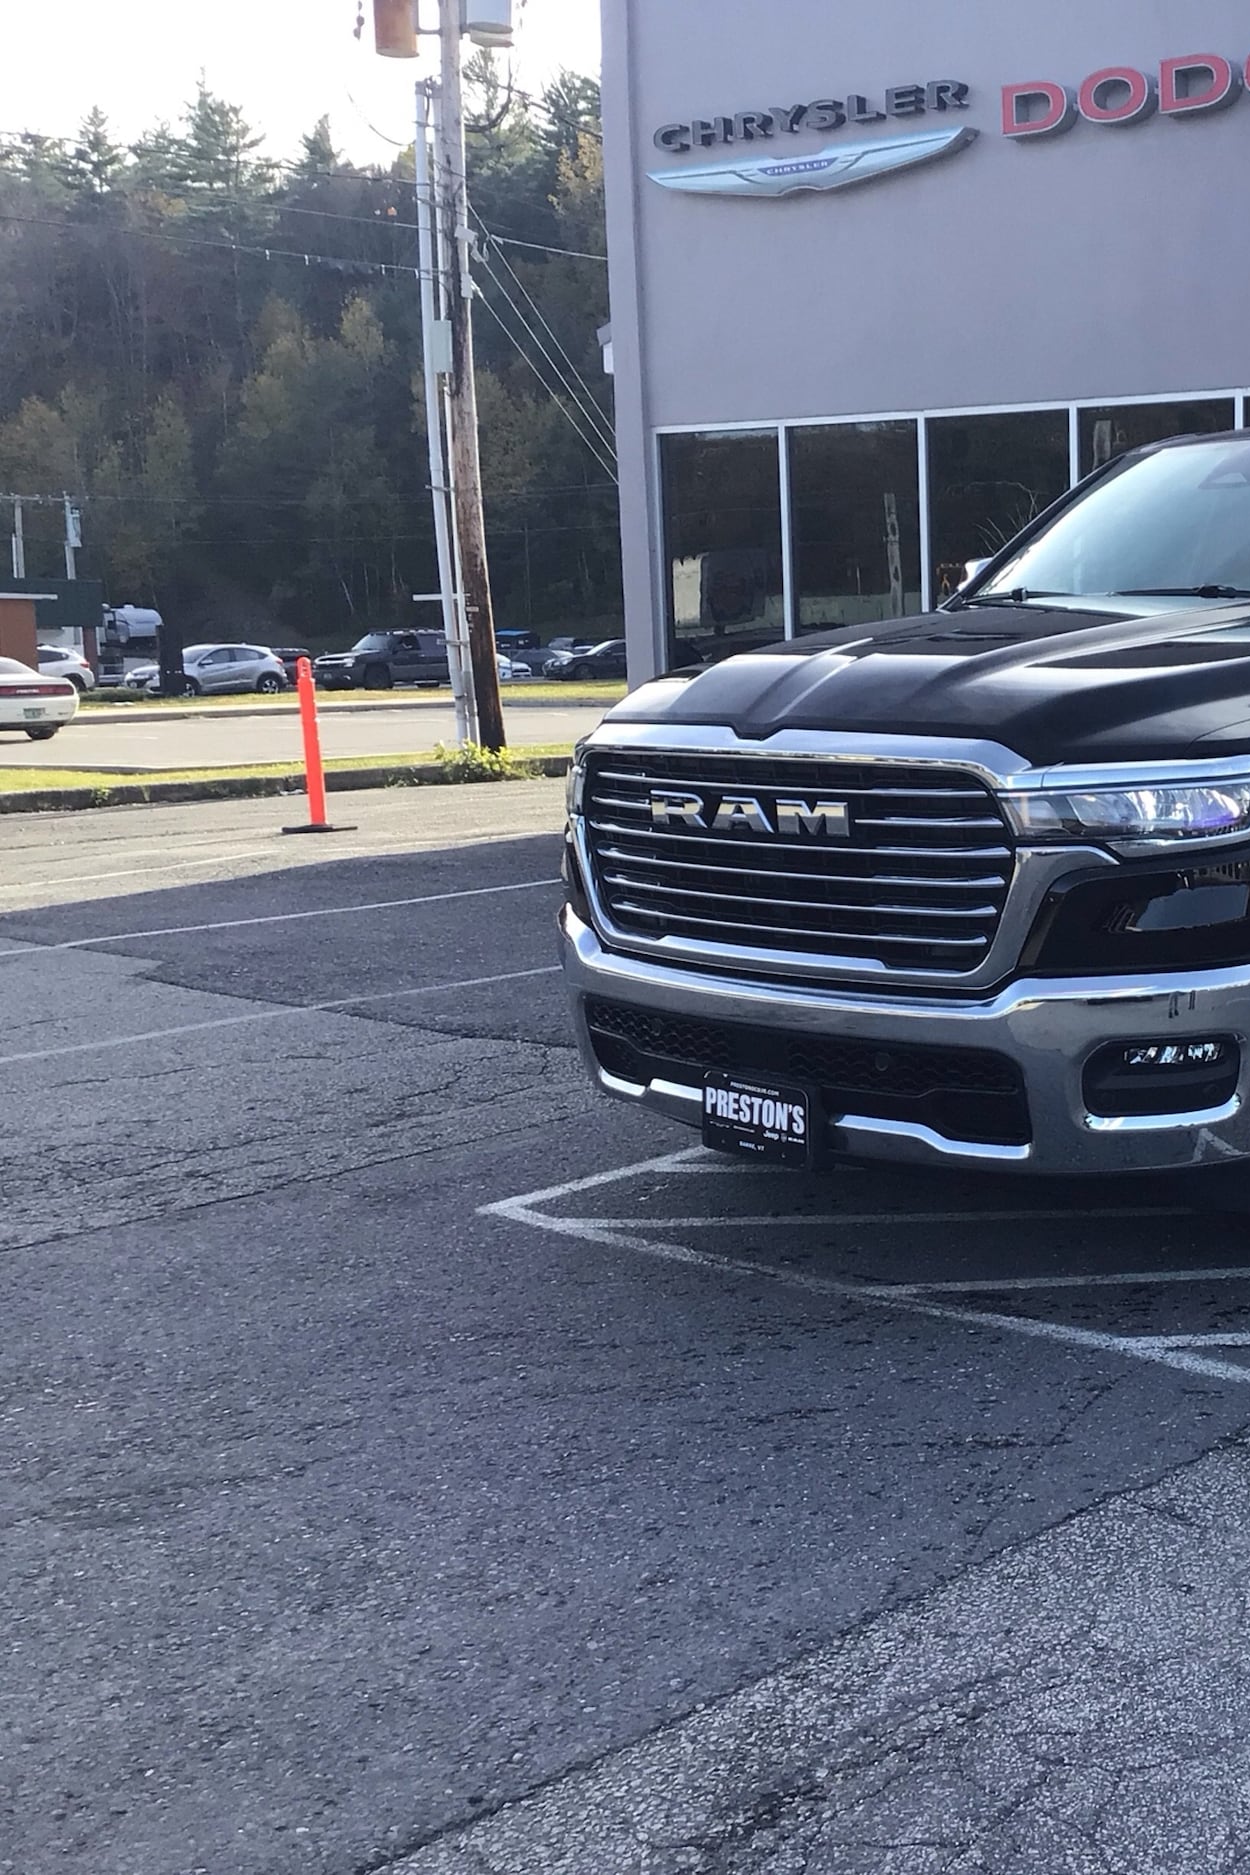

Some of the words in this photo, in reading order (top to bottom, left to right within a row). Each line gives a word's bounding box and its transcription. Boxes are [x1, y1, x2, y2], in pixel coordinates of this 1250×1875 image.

[653, 79, 969, 151] CHRYSLER
[766, 160, 828, 175] CHRYSLER
[650, 788, 850, 838] RAM
[705, 1086, 805, 1135] PRESTON'S
